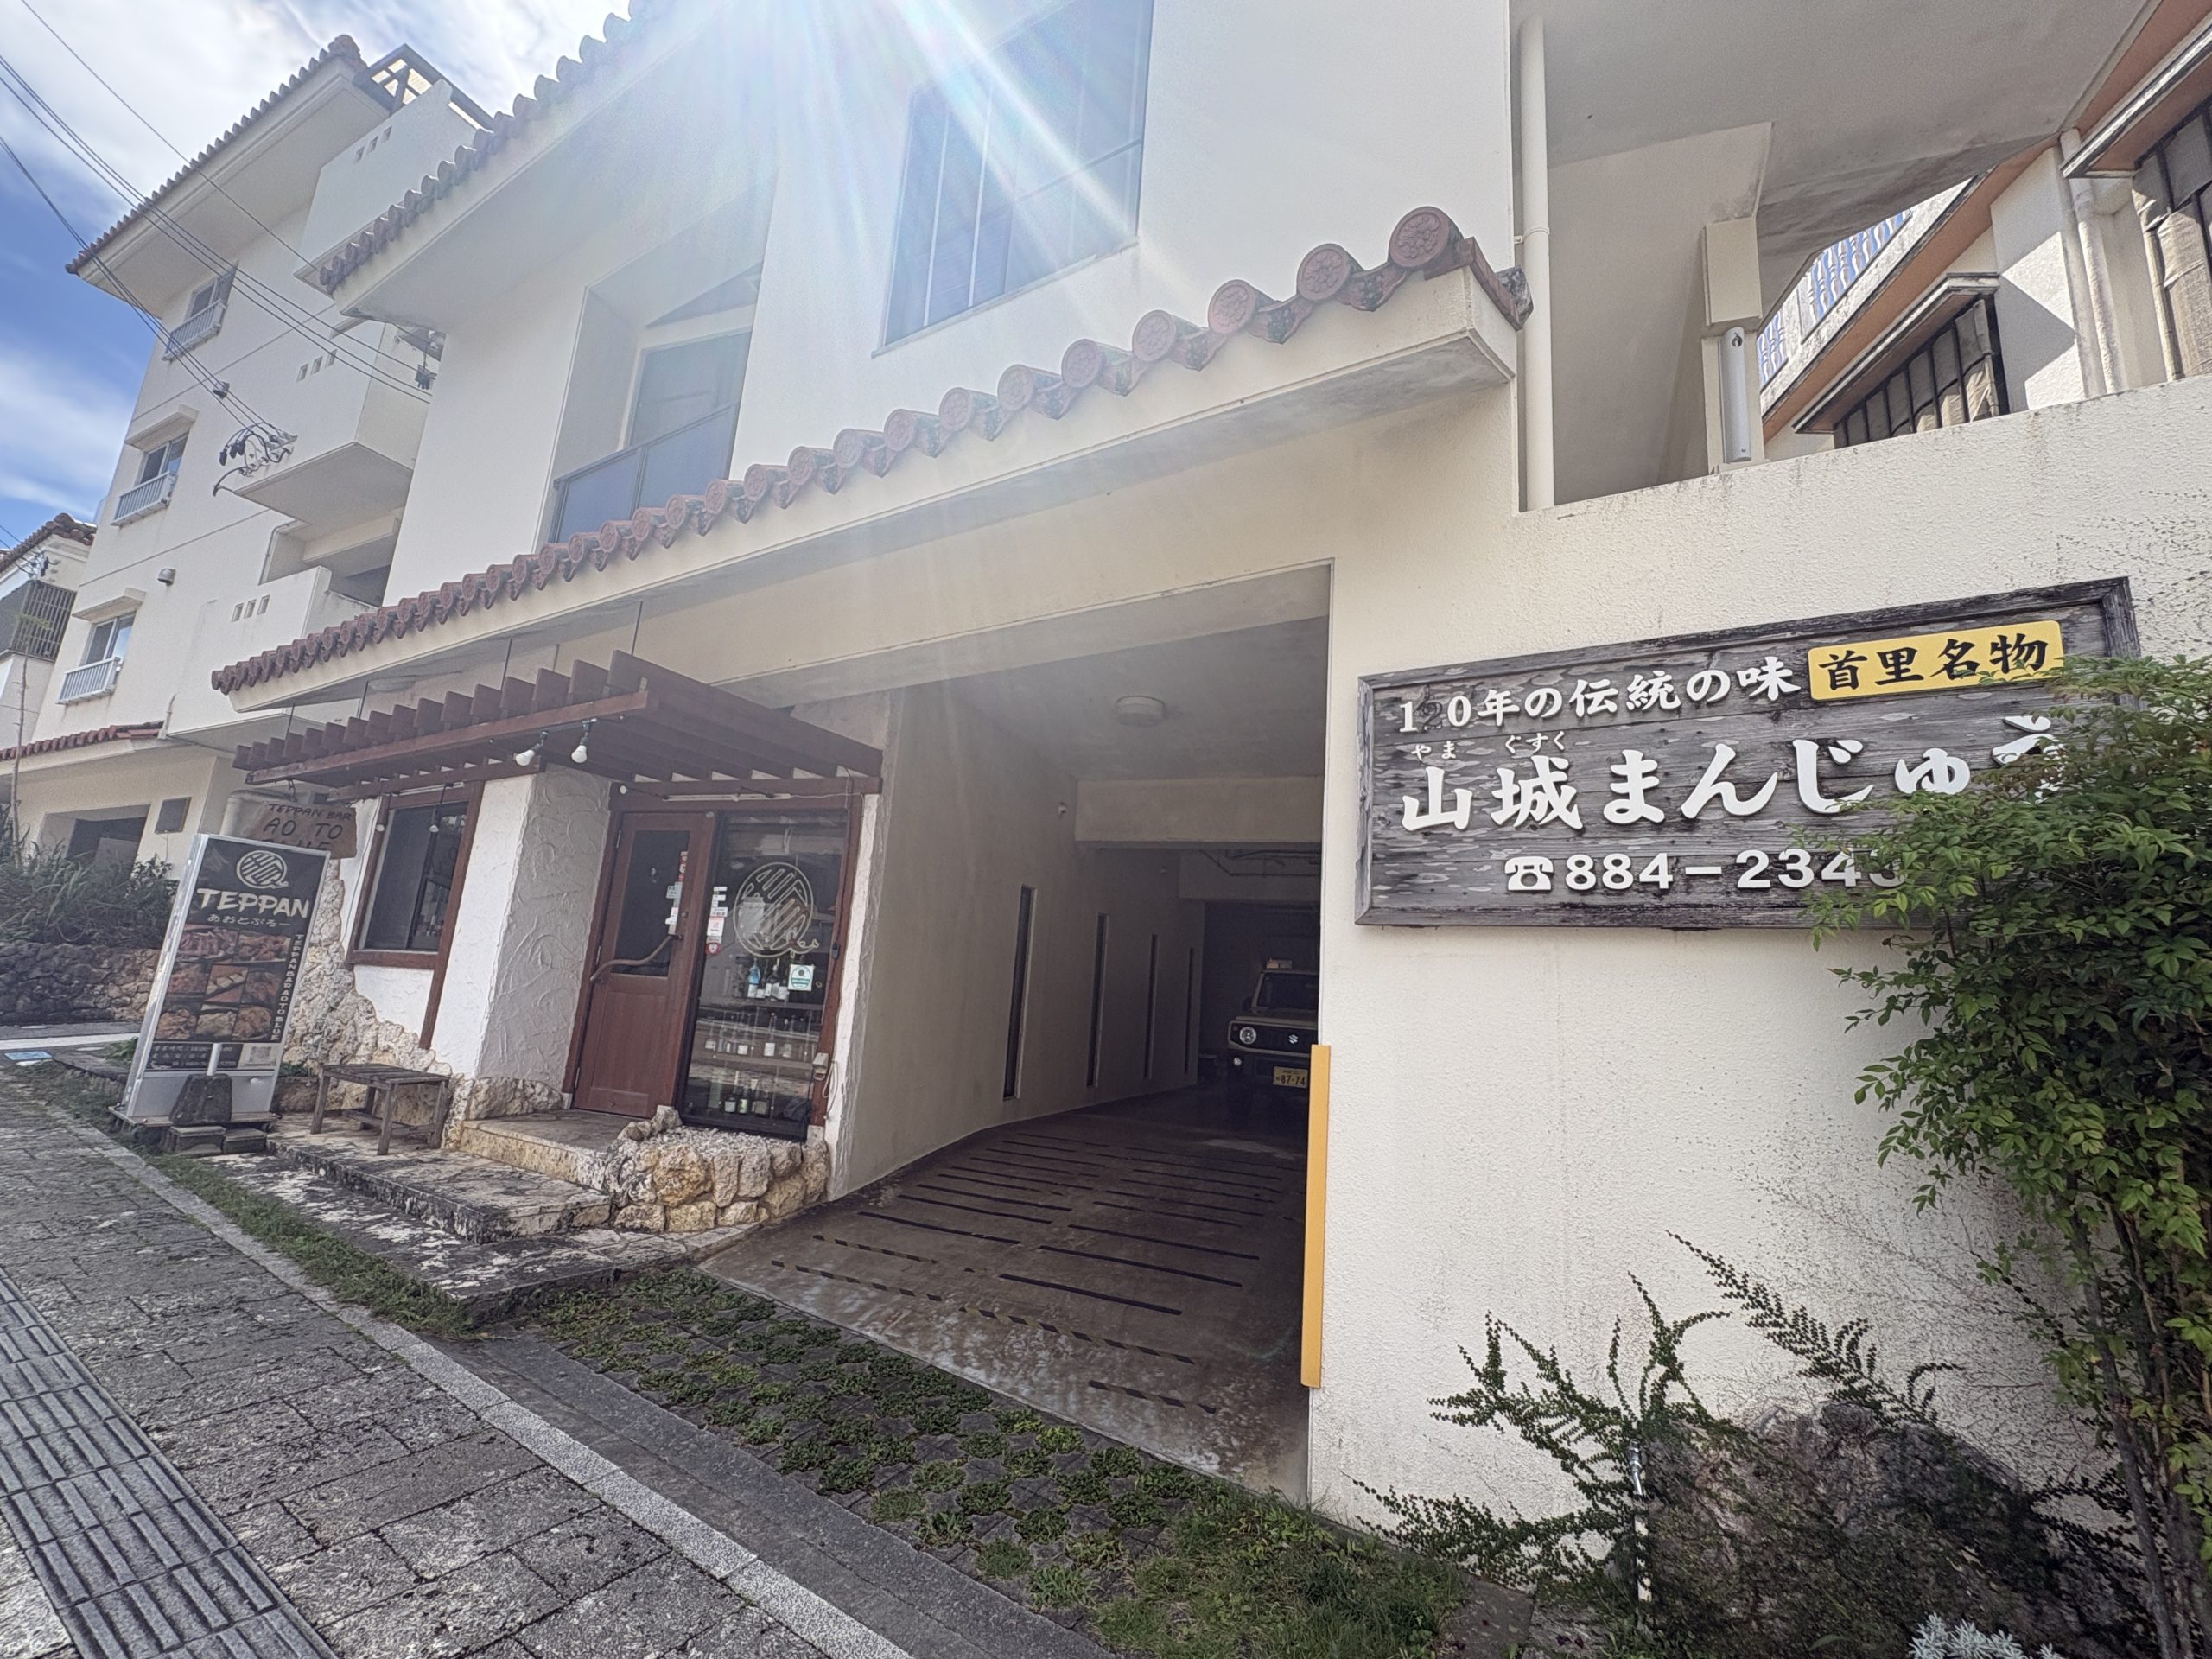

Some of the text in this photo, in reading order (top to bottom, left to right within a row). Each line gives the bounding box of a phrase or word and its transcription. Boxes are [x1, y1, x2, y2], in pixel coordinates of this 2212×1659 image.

[1818, 632, 2049, 691] 首里名物
[1410, 730, 1567, 761] やま ぐすく
[269, 803, 352, 822] TEPPAN BAR
[196, 887, 310, 919] TEPPAN
